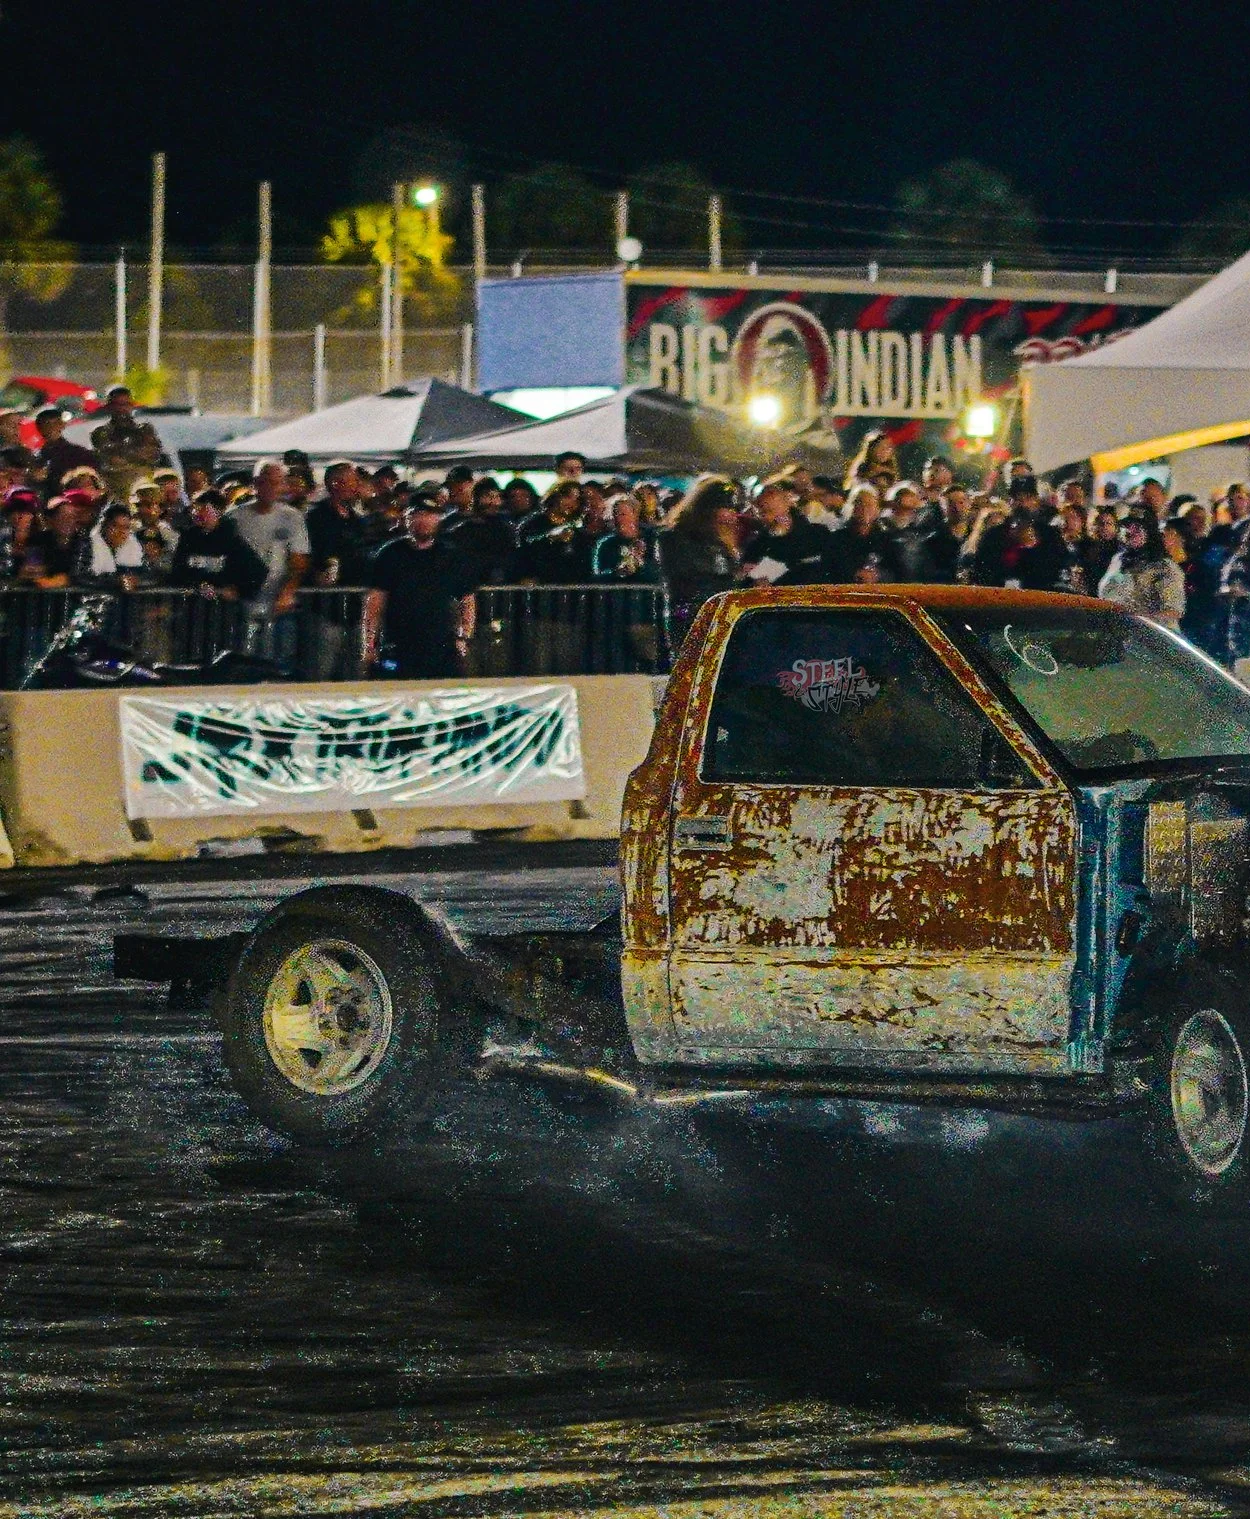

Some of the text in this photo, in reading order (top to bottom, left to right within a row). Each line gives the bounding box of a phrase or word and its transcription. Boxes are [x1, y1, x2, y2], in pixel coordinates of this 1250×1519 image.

[650, 322, 982, 412] BIG INDIAN
[791, 656, 862, 686] STEEL
